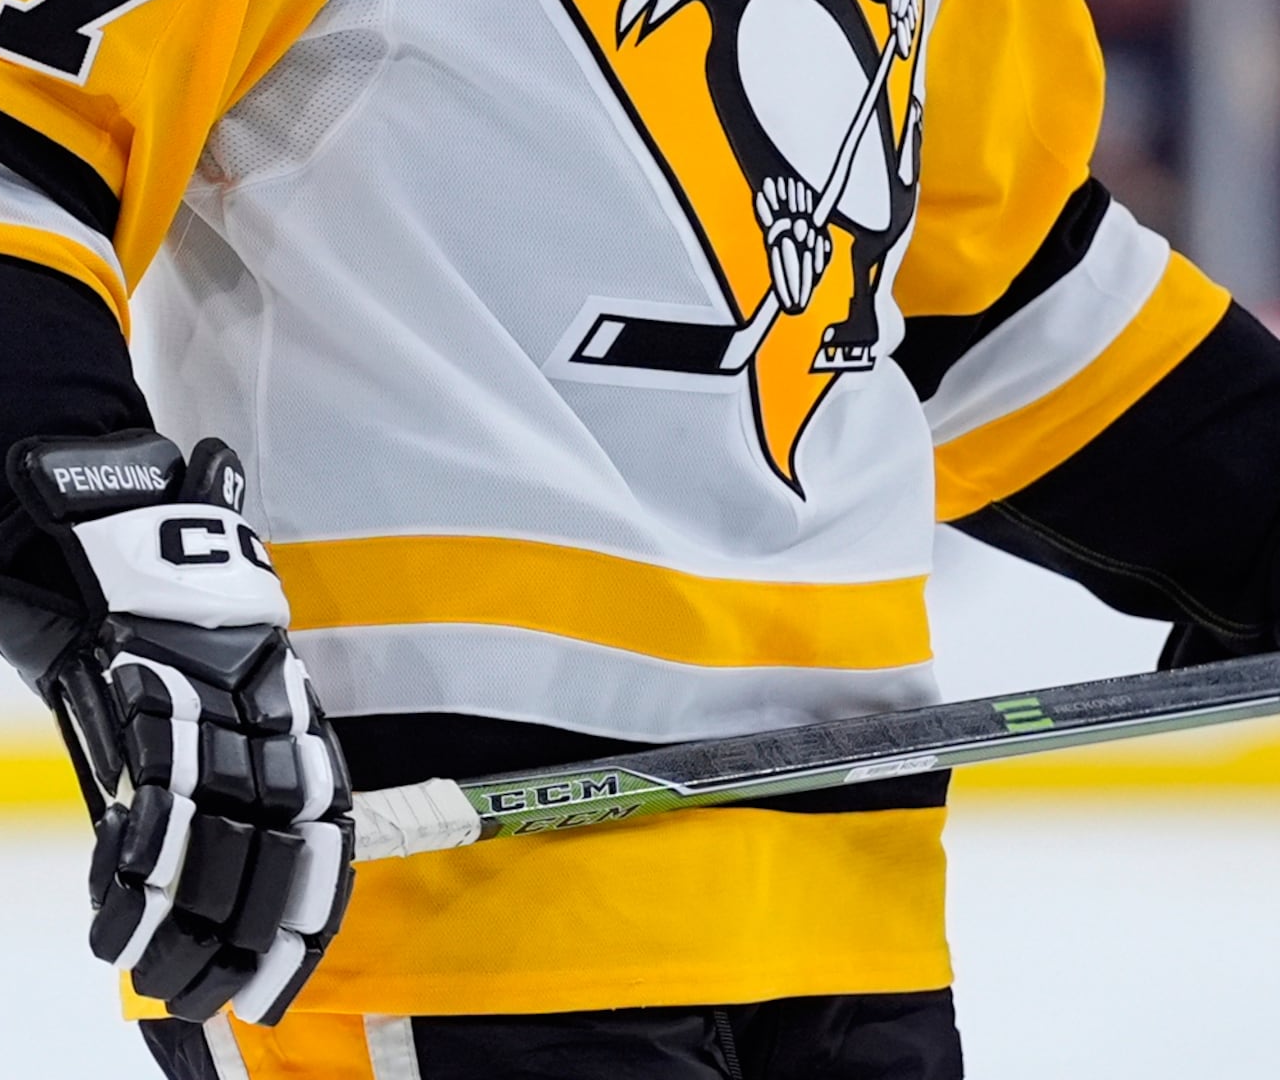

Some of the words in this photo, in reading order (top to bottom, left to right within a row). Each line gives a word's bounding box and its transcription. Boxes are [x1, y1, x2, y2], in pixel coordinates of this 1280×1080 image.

[53, 464, 166, 494] PENGUINS
[222, 466, 245, 511] 87
[482, 774, 619, 813] CCM
[513, 803, 646, 835] CCM
